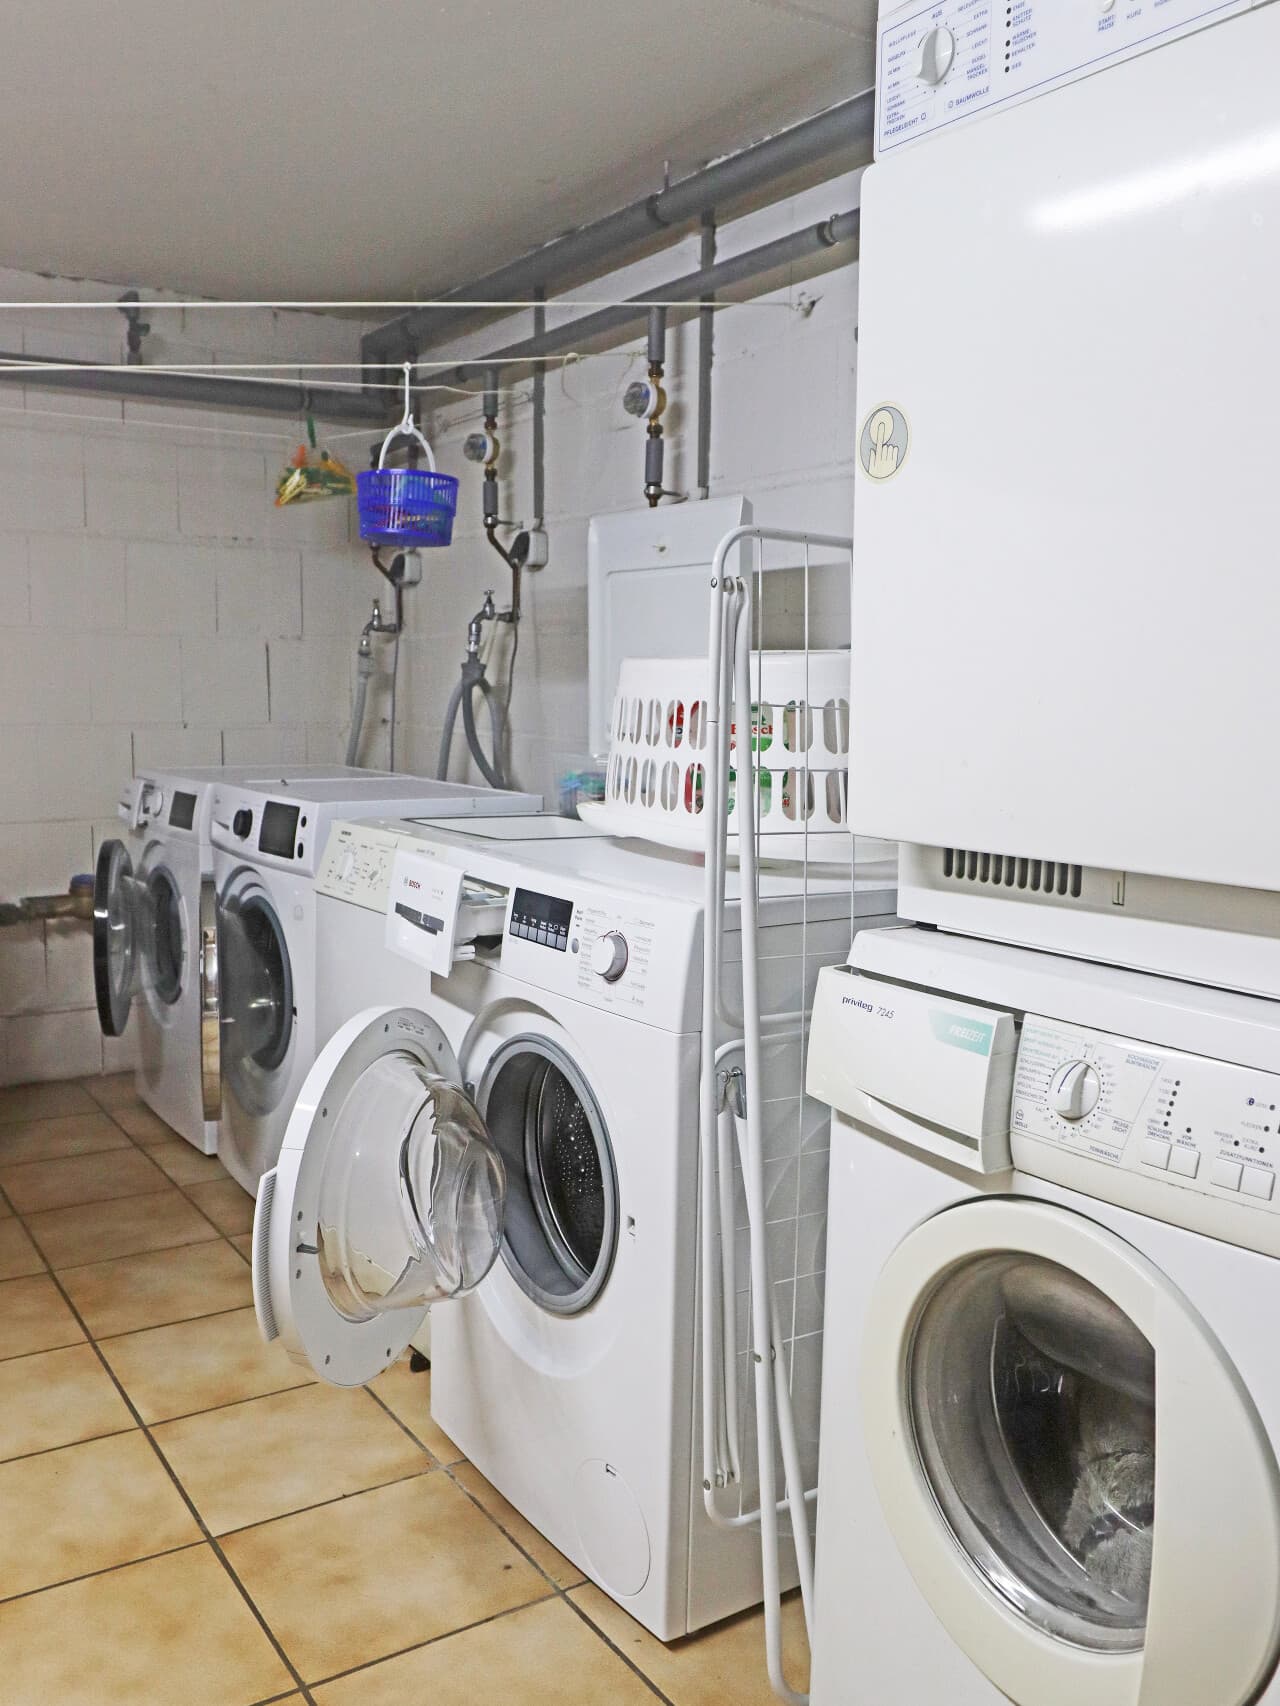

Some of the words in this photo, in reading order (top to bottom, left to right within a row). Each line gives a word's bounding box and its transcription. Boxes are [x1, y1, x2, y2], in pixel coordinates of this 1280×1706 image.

[956, 86, 990, 106] BAUMWOLLE
[884, 117, 919, 136] PFLEGELEICHT
[842, 995, 873, 1012] privileg
[876, 1006, 895, 1019] 7245
